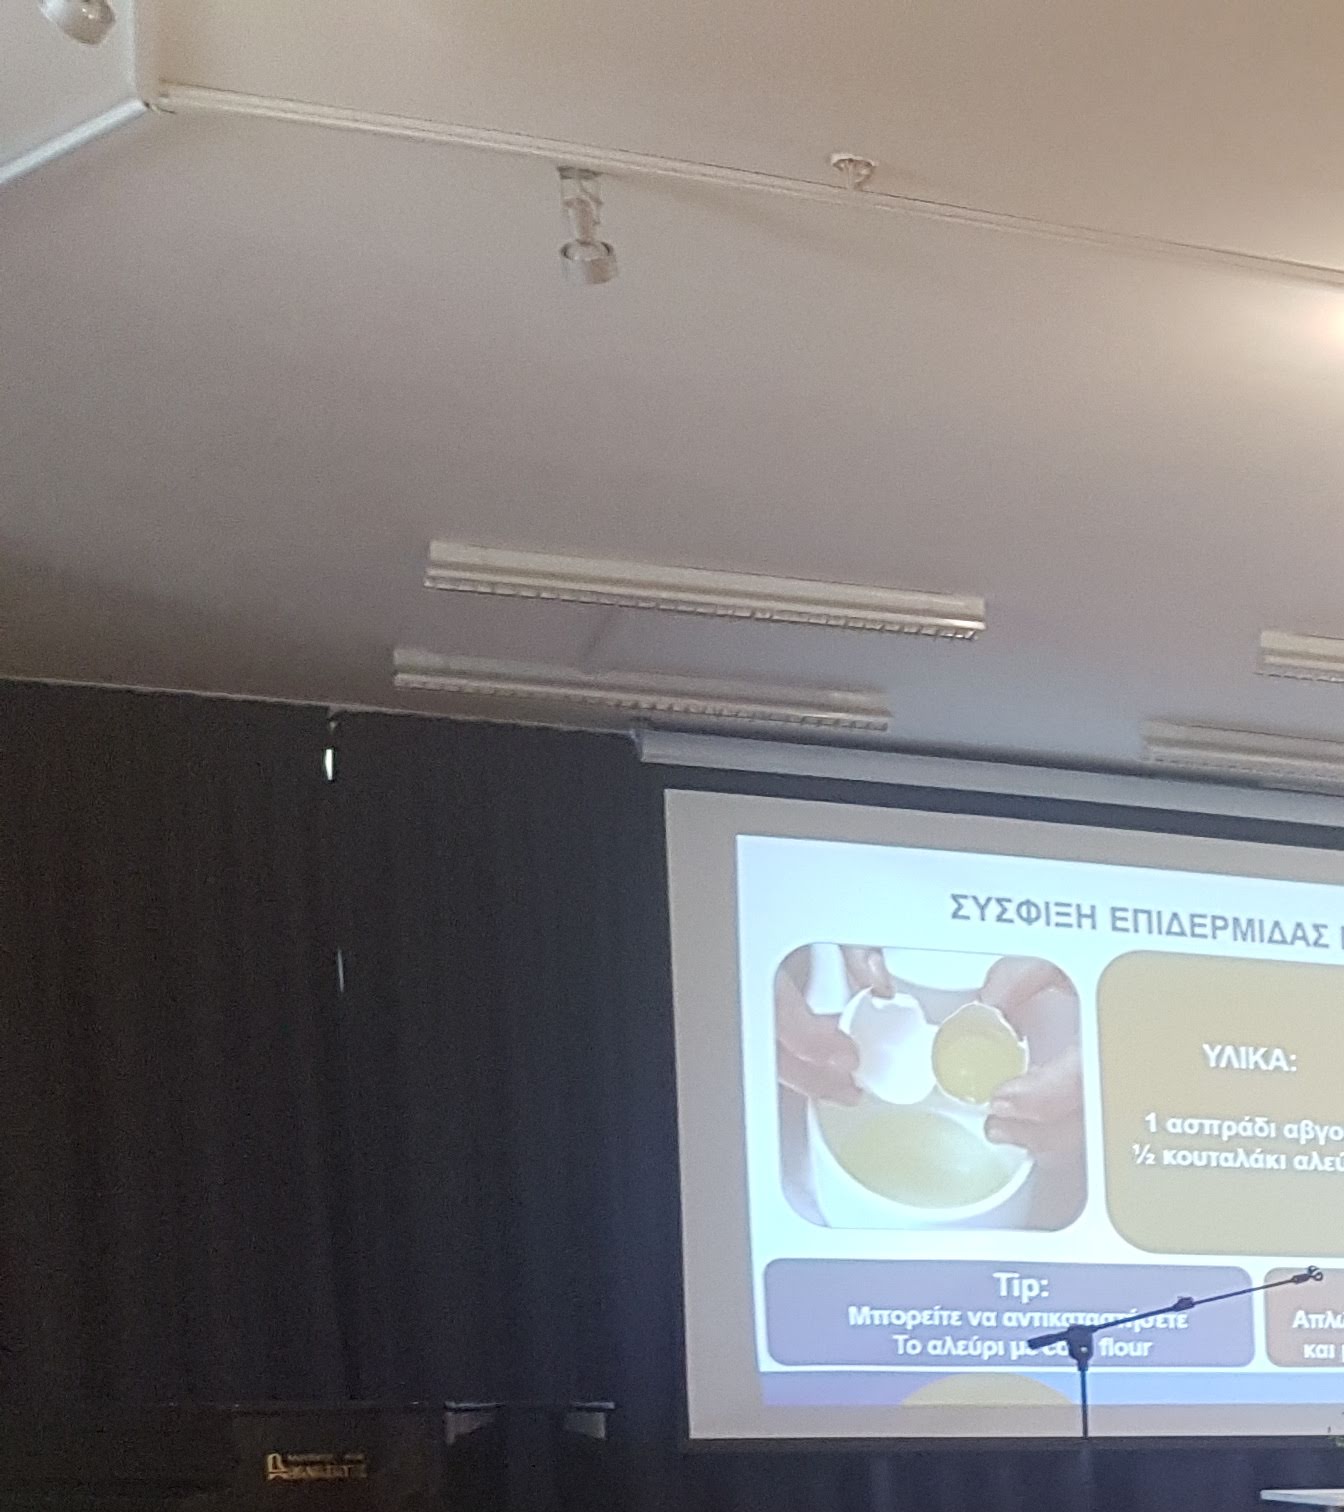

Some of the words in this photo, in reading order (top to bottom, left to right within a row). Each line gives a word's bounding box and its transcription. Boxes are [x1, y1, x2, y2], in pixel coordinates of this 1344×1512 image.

[950, 892, 1098, 931] ΣΥΣΦΙΞΗ
[1109, 906, 1330, 949] ΕΠΙΔΕΡΜΙΔΑΣ
[1202, 1043, 1298, 1072] ΥΛΙΚΑ:
[1144, 1111, 1158, 1133] 1
[1165, 1115, 1277, 1141] ασπράδι
[1162, 1147, 1287, 1170] κουταλάκι
[992, 1272, 1049, 1305] Tip:
[847, 1306, 962, 1331] Μπορείτε
[967, 1310, 998, 1328] να
[892, 1334, 921, 1356] Το
[926, 1335, 1004, 1361] αλεύρι
[1098, 1336, 1153, 1357] flour
[1303, 1344, 1338, 1360] και
